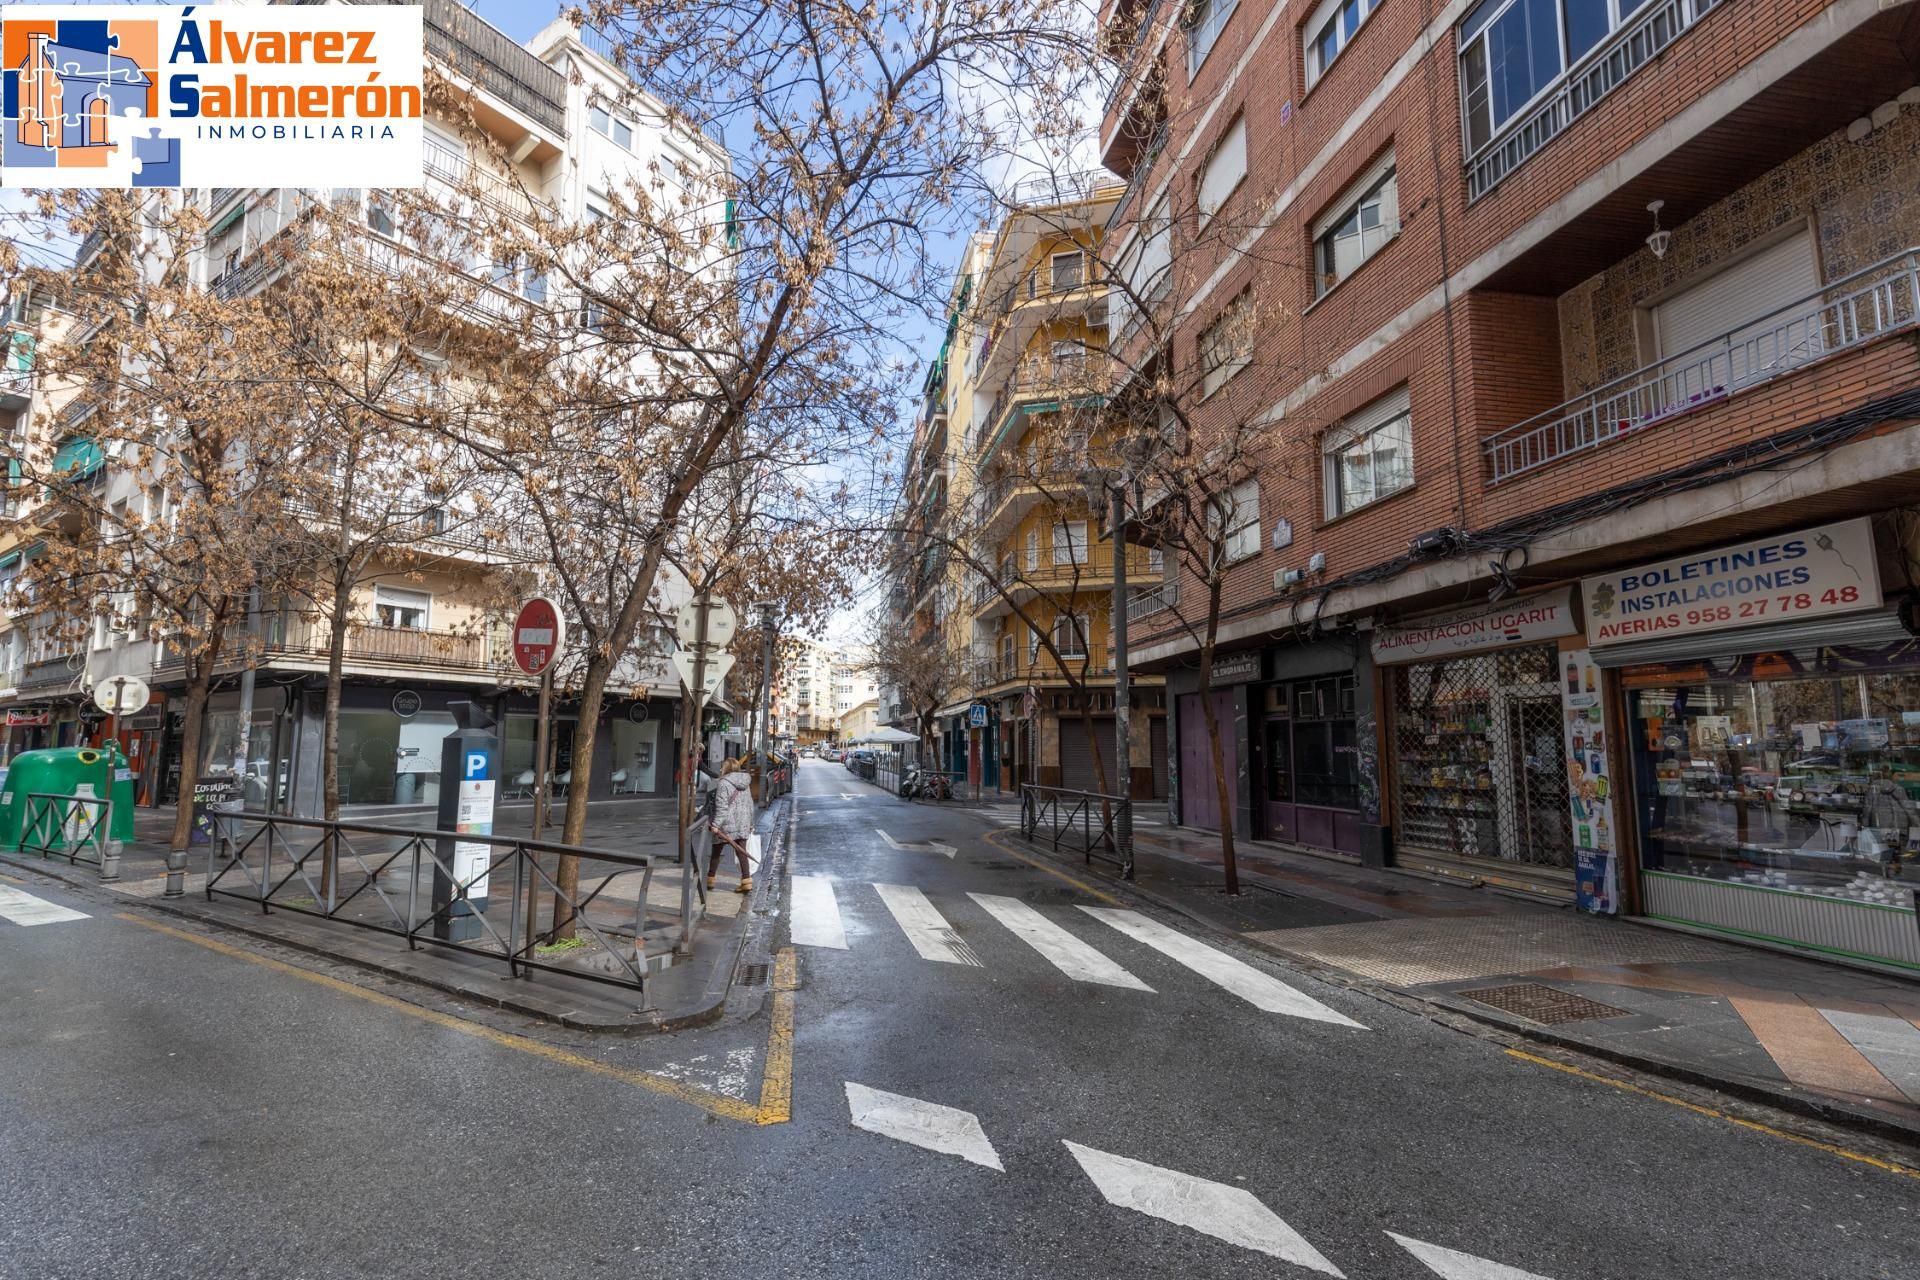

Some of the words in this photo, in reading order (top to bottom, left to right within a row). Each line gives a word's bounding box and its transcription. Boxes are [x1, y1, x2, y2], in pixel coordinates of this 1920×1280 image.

[1621, 540, 1807, 592] BOLETINES
[1621, 566, 1810, 614] INSTALACIONES
[1379, 622, 1485, 649] ALIMENTACION
[1490, 606, 1557, 630] UGARIT
[1599, 614, 1680, 638] AVERIAS
[1687, 606, 1731, 625] 958
[1739, 599, 1769, 618] 27
[1777, 592, 1812, 612] 78
[1820, 585, 1860, 605] 48
[467, 754, 486, 777] P
